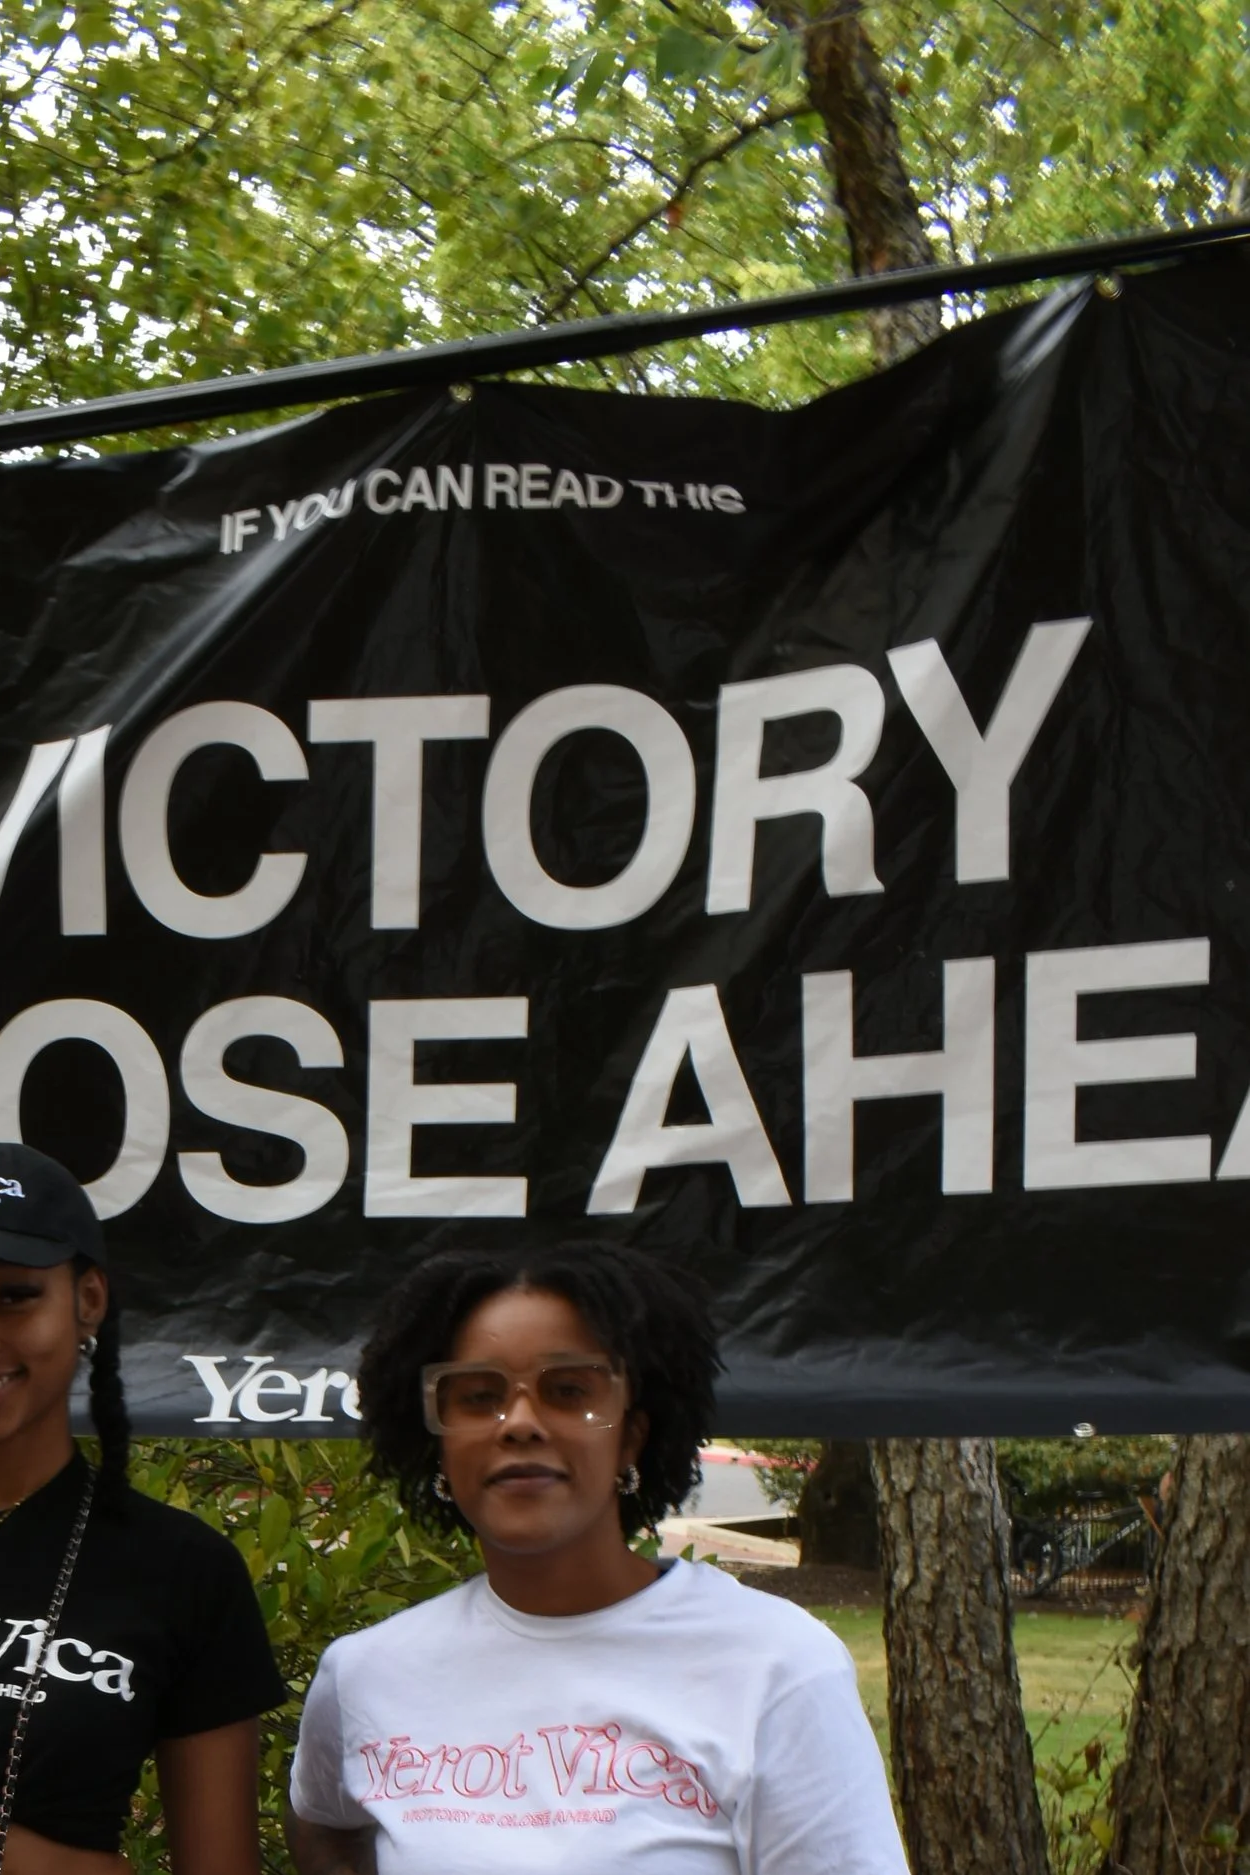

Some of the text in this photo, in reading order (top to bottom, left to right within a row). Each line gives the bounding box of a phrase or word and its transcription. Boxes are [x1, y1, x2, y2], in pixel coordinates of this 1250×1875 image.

[219, 463, 747, 554] IF YOU CAN READ THIS
[586, 936, 1250, 1216] AHE
[359, 1722, 718, 1819] Yerot Vica
